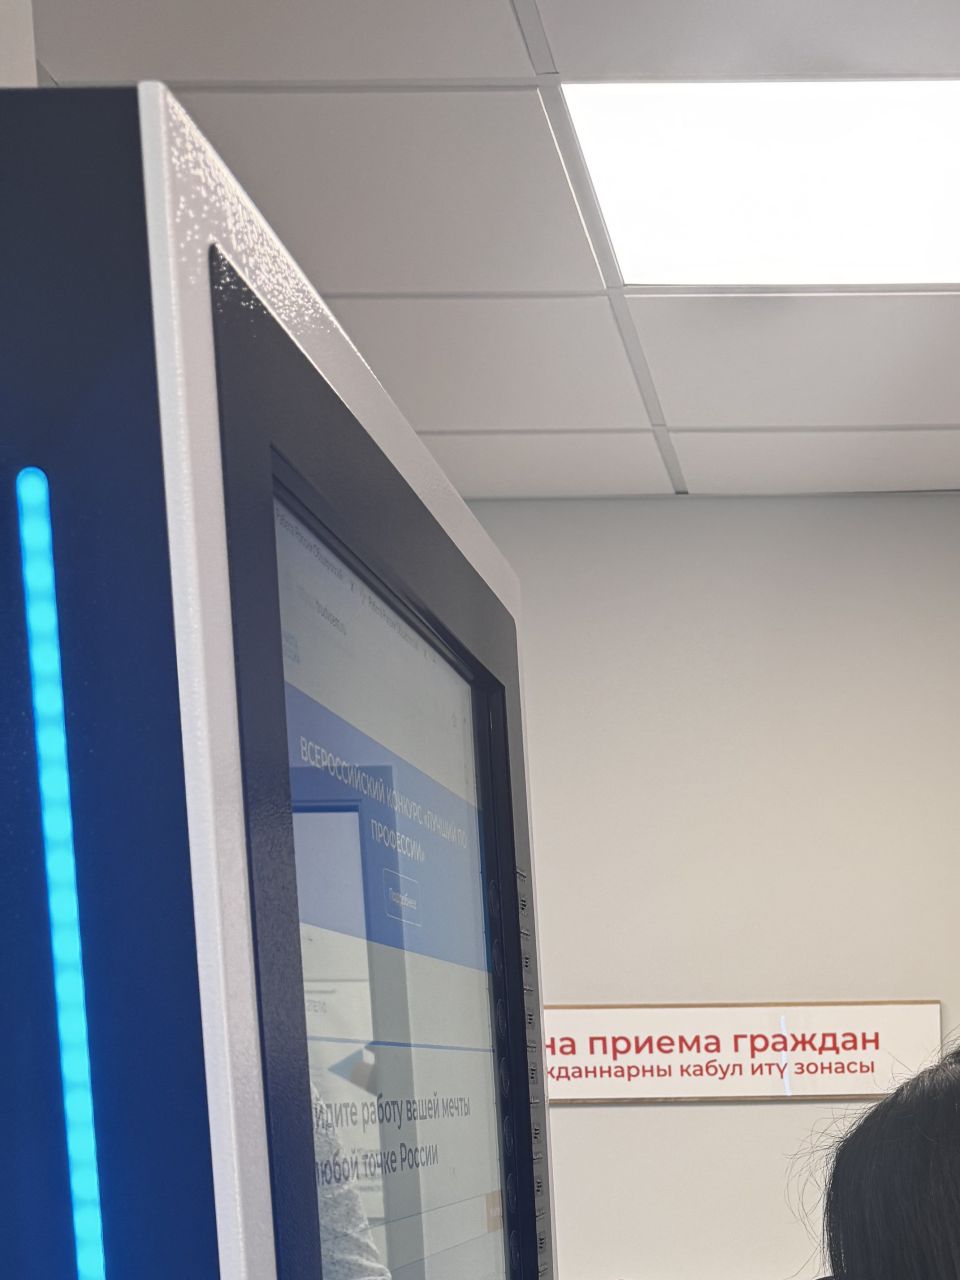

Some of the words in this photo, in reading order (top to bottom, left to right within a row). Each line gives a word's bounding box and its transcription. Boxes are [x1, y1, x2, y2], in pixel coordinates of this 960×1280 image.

[589, 1033, 721, 1061] приема
[733, 1031, 880, 1059] граждан
[679, 1058, 743, 1081] кабул
[794, 1060, 875, 1075] зонасы
[361, 1092, 403, 1133] работу
[406, 1091, 440, 1122] вашей
[442, 1097, 471, 1118] мечты
[362, 1151, 397, 1179] точке
[400, 1143, 439, 1172] России
